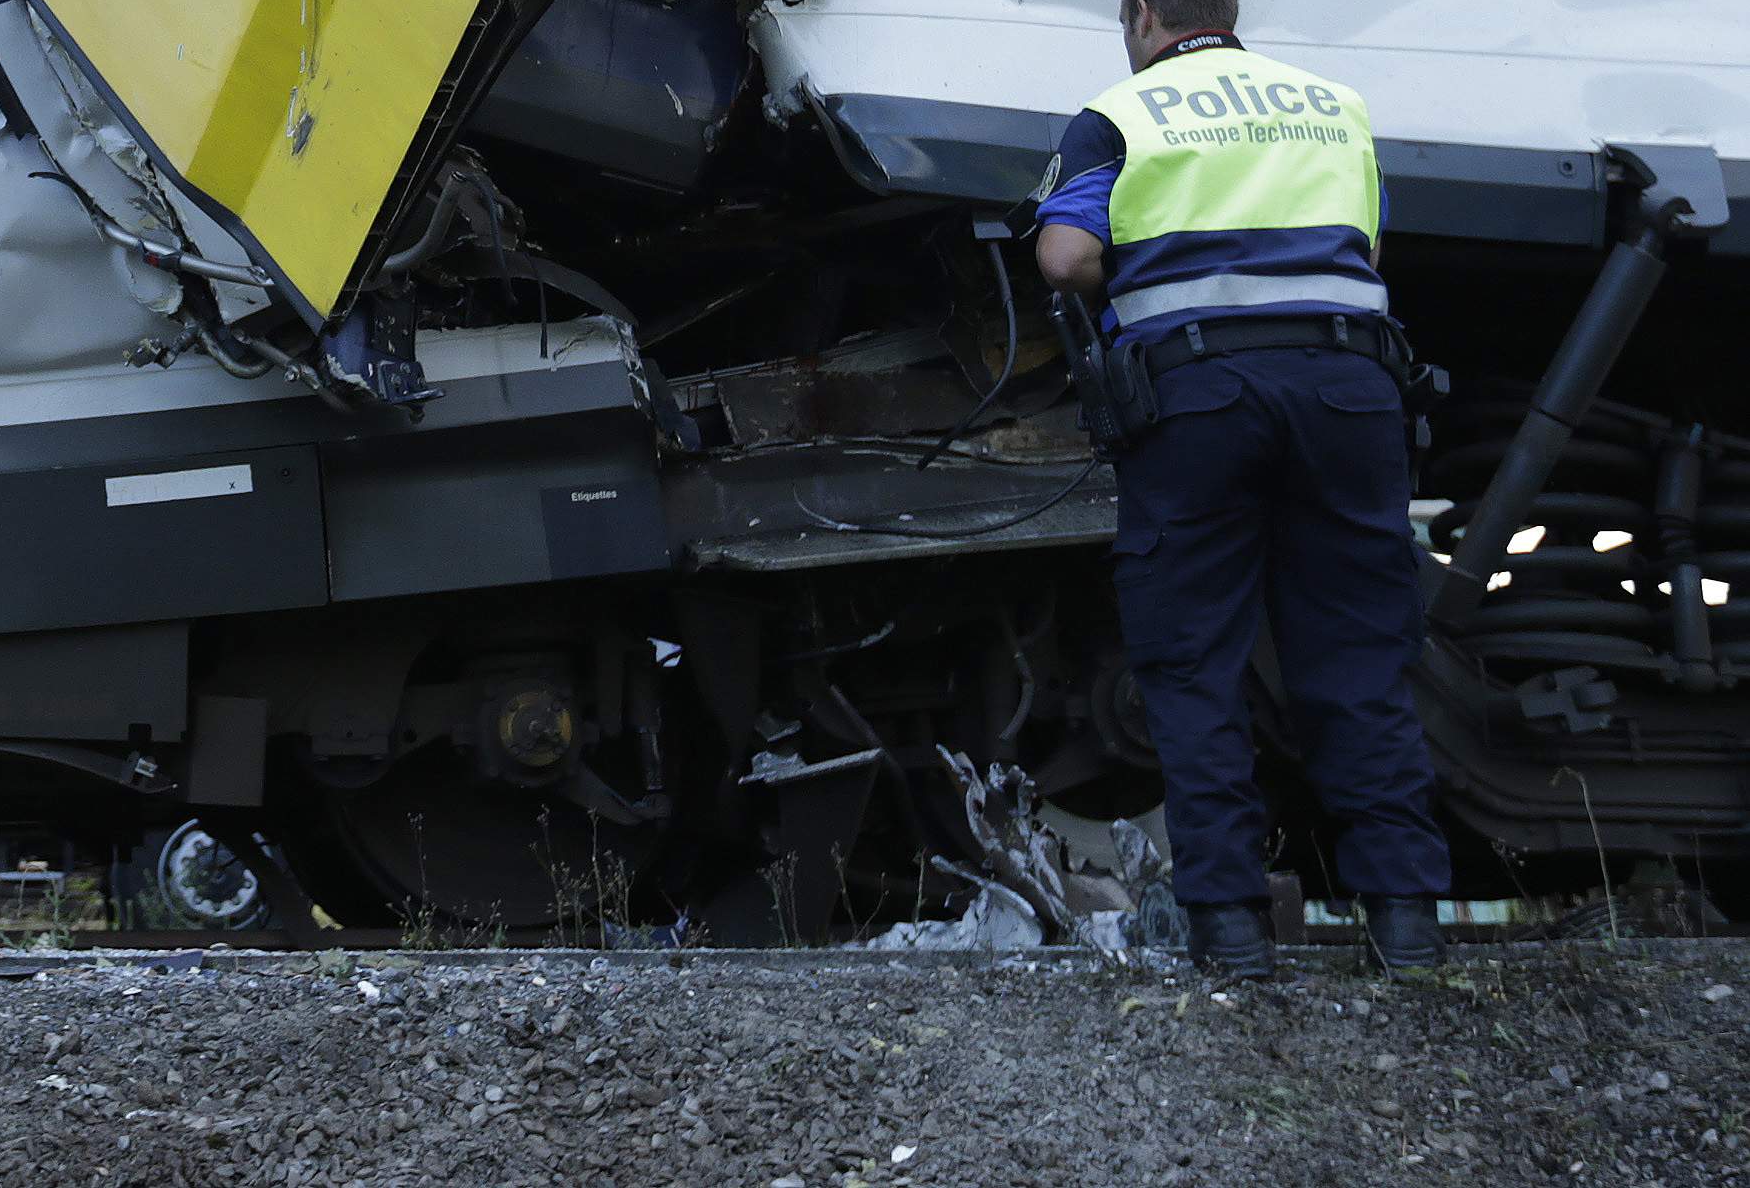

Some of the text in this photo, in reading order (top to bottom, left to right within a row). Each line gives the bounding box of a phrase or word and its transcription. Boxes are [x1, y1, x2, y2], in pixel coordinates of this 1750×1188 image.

[1177, 34, 1224, 53] Canon
[1136, 73, 1342, 126] Police
[1162, 120, 1349, 148] Groupe Technique
